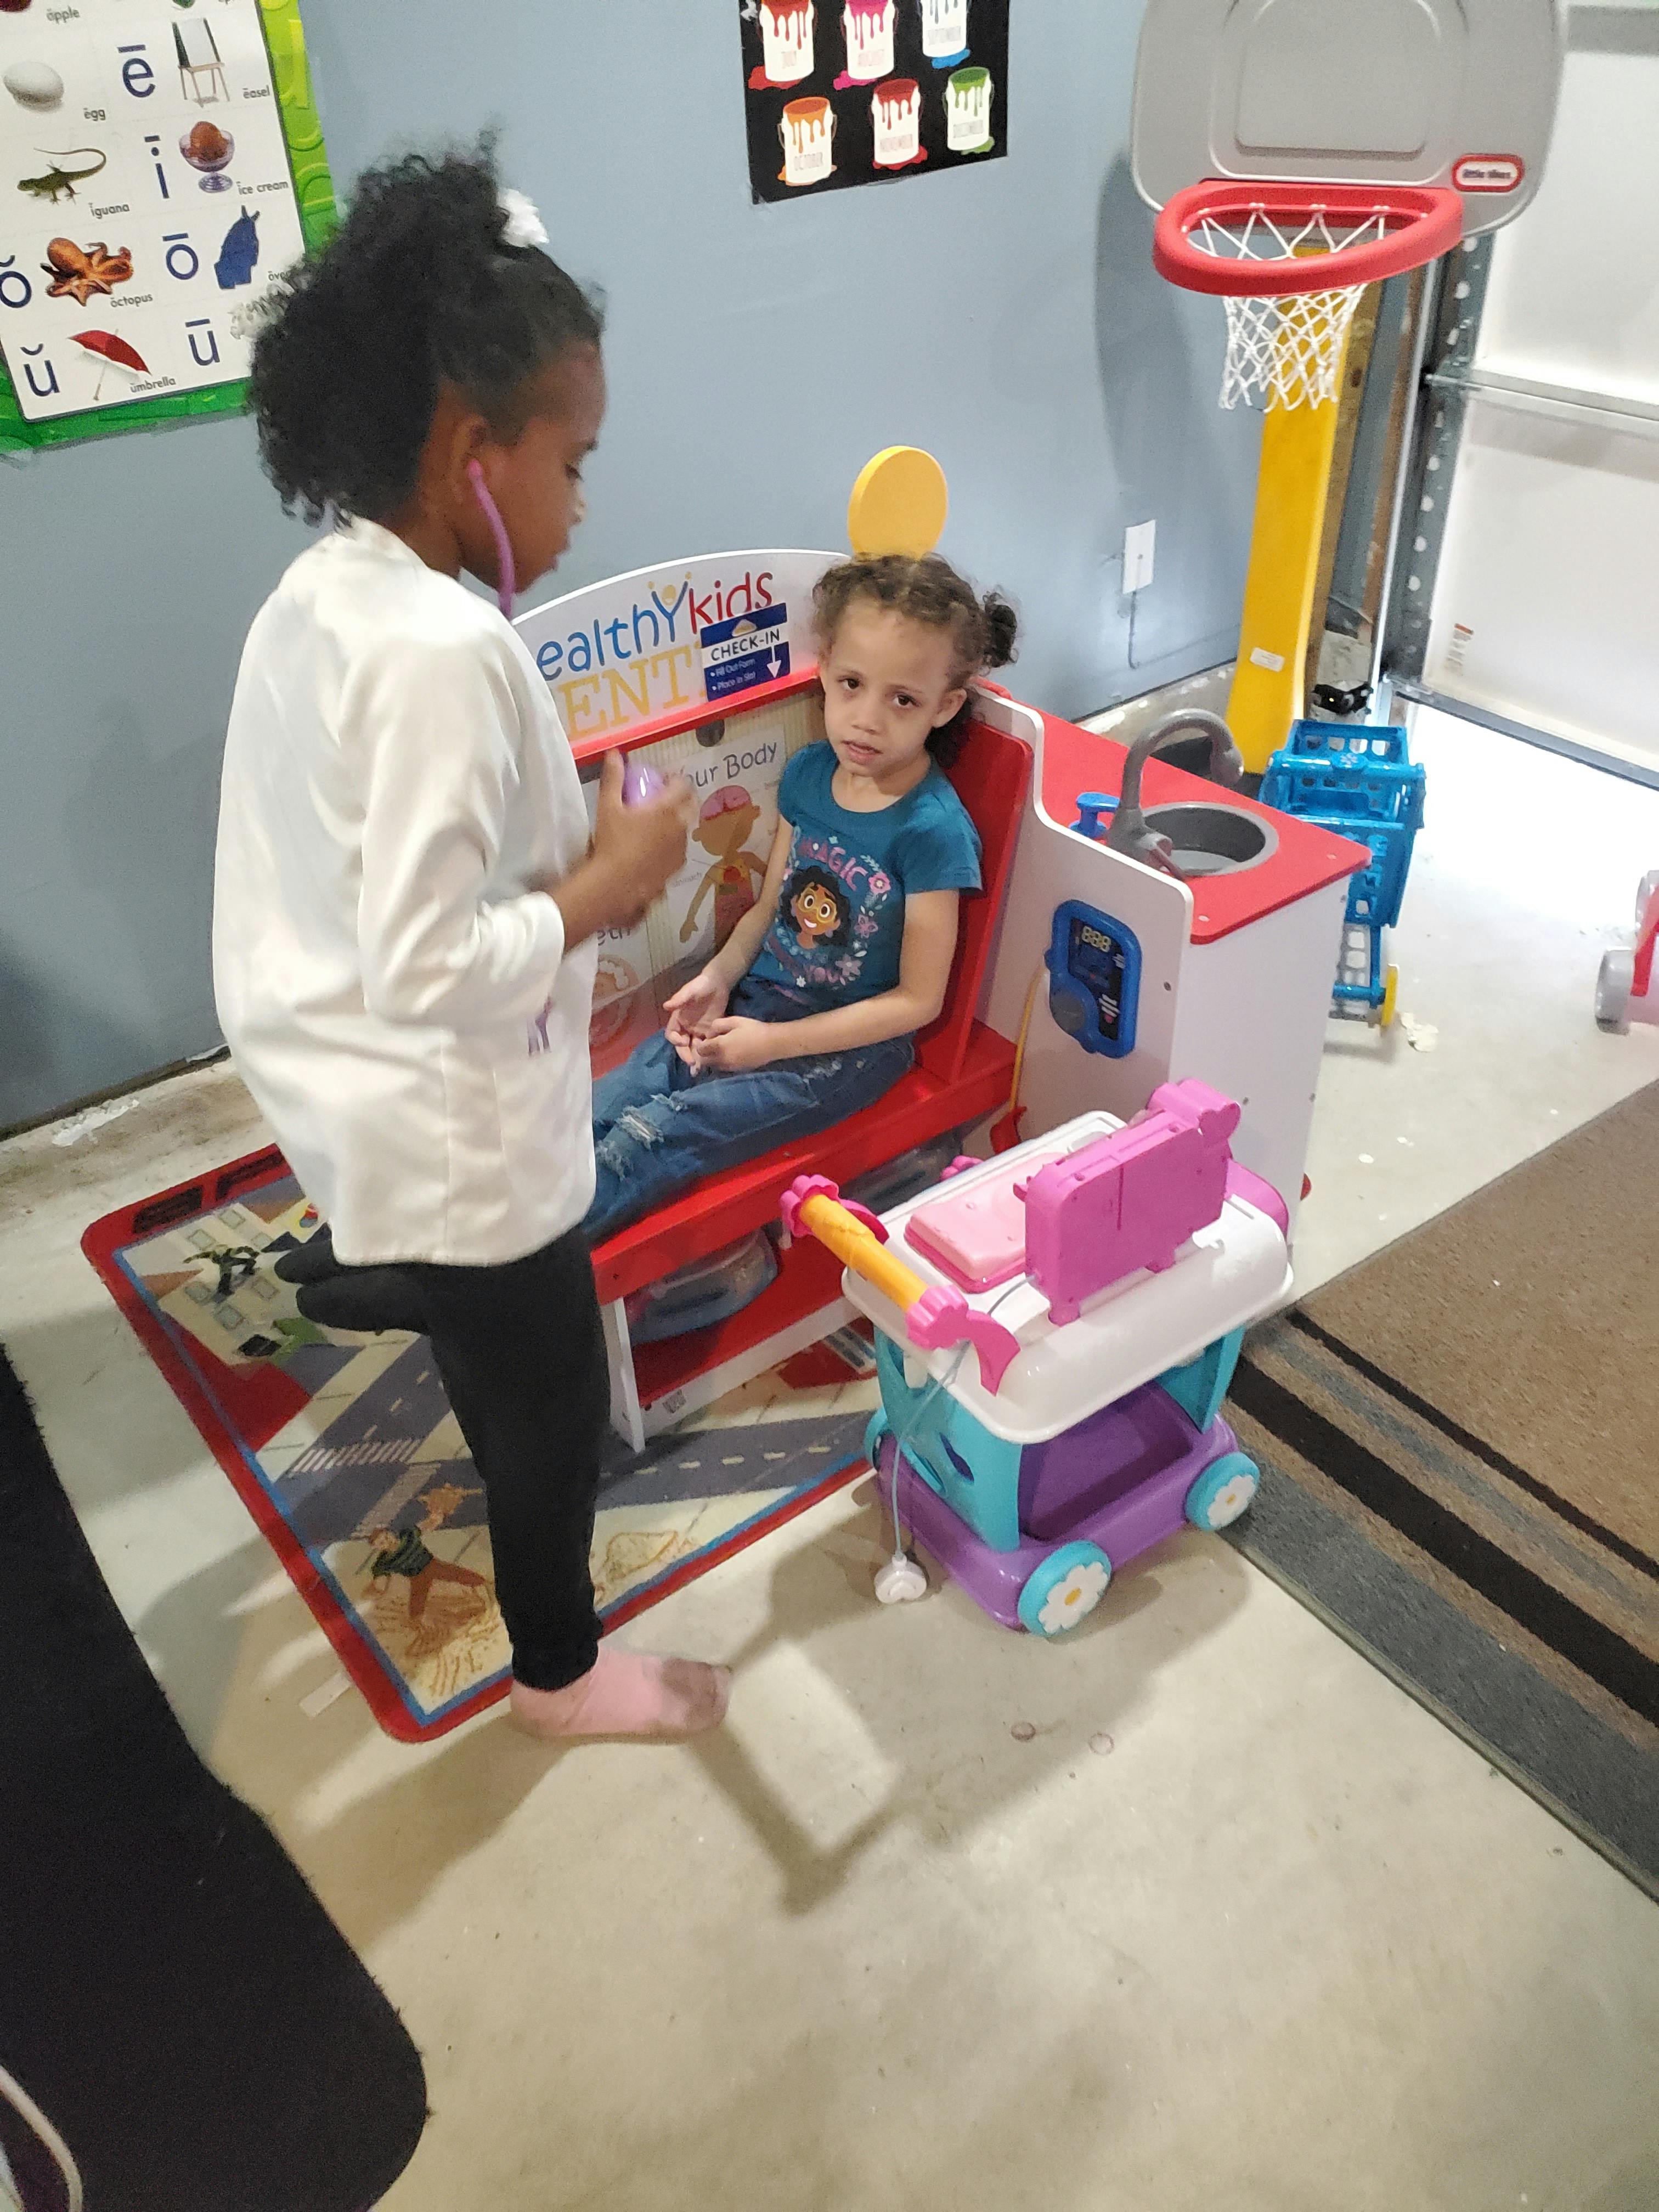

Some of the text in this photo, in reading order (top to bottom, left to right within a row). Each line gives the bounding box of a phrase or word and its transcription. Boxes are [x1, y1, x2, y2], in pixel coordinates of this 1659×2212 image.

[257, 181, 289, 193] cream
[710, 628, 780, 661] CHECK-IN
[723, 742, 777, 779] Body
